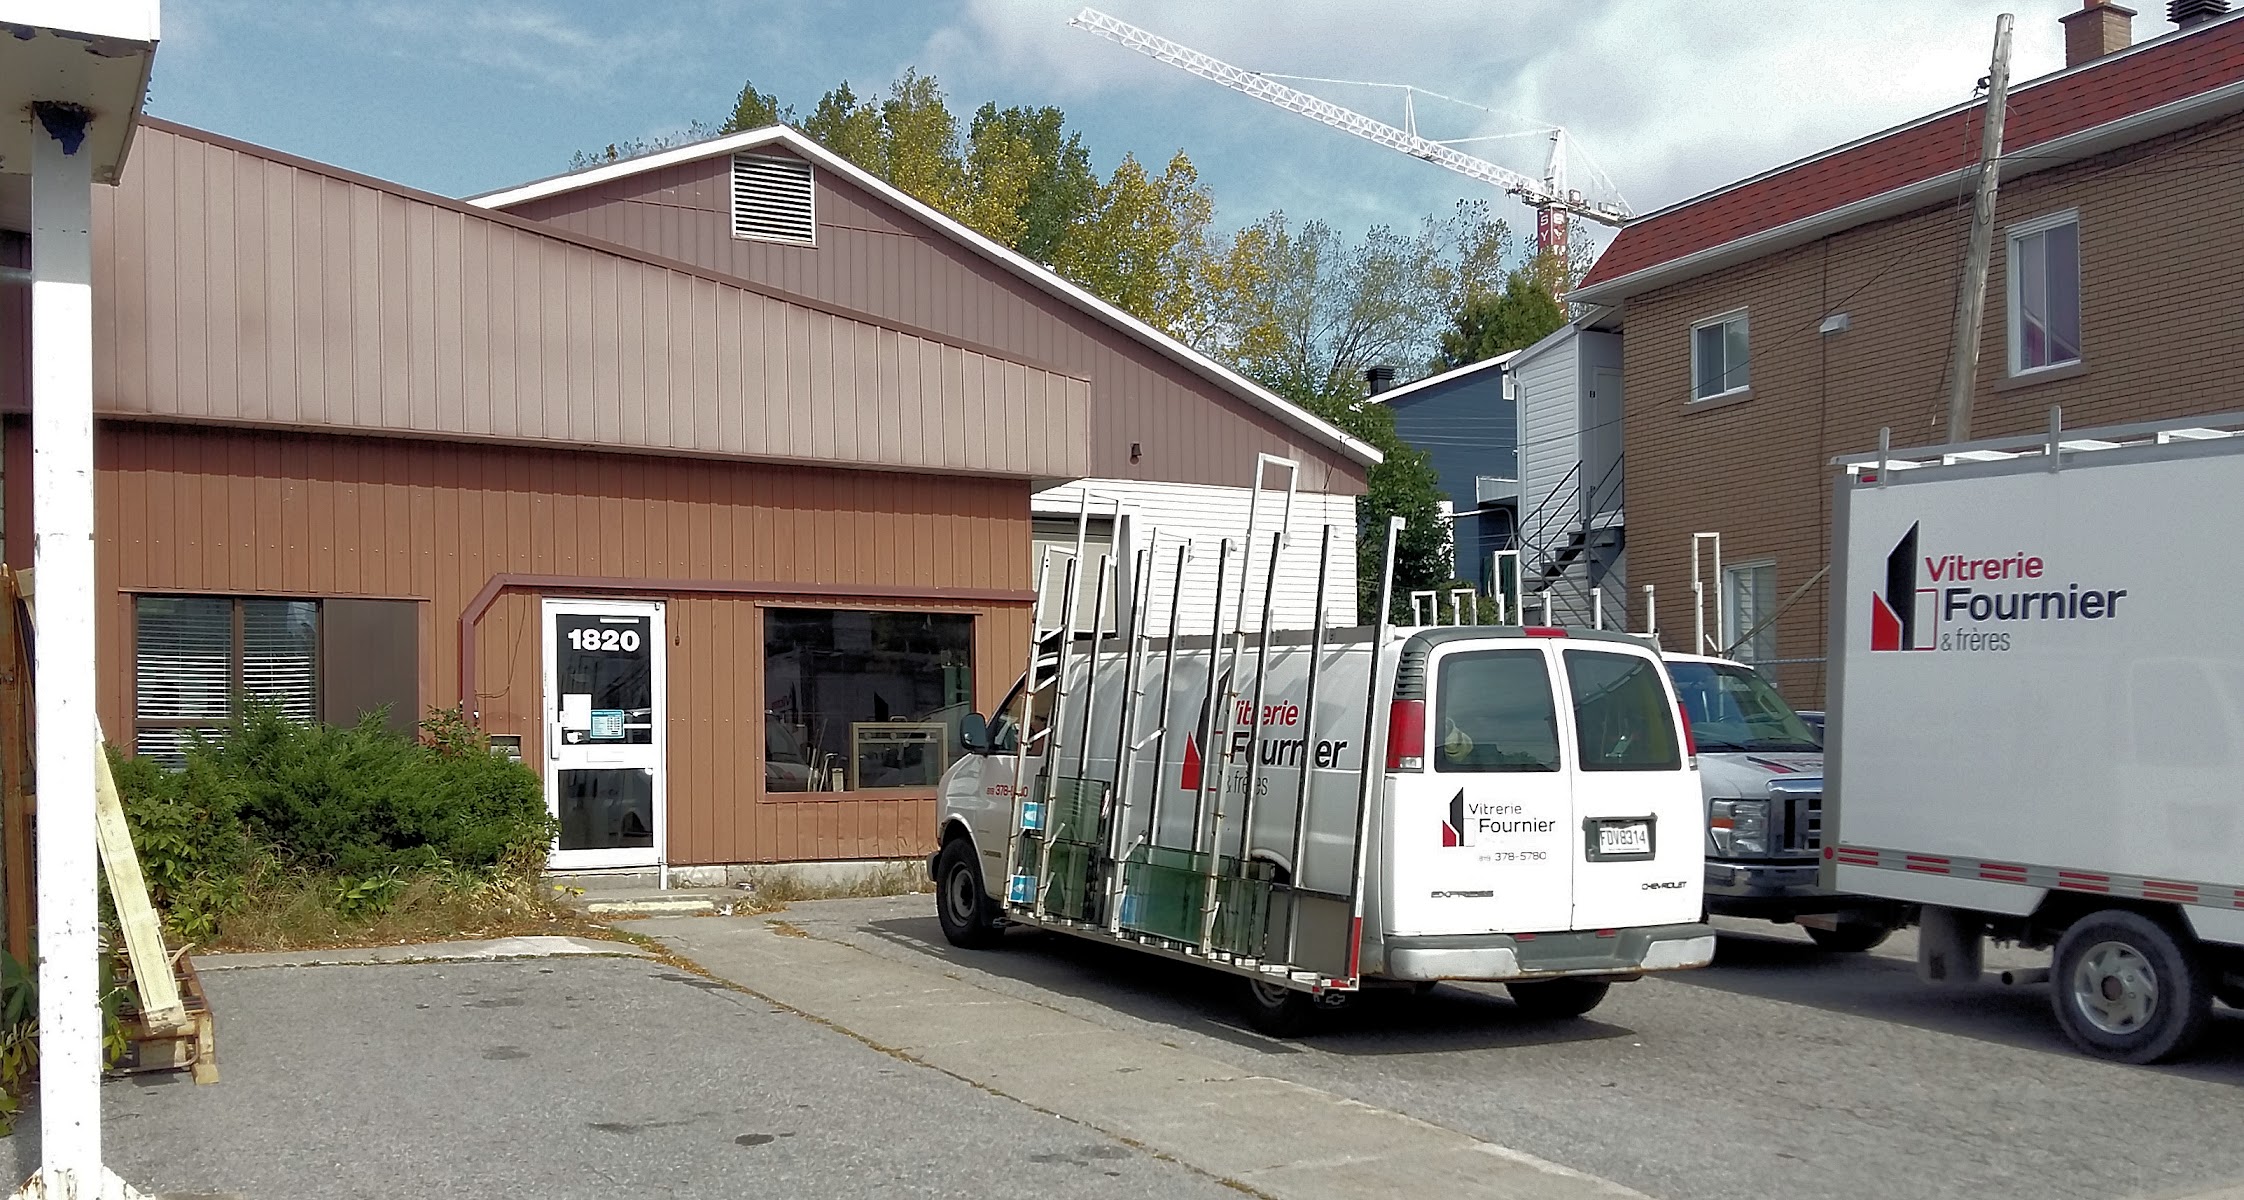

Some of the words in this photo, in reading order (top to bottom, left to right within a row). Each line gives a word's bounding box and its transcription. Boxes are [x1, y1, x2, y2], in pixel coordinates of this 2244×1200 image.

[1925, 551, 2045, 582] Vitrerie
[1943, 583, 2128, 622] Fournier
[567, 628, 641, 652] 1820
[1940, 633, 1953, 651] &
[1955, 626, 2011, 652] frères
[1236, 700, 1299, 726] iterie
[1229, 731, 1348, 768] Furner
[1233, 770, 1269, 796] frèes
[1468, 803, 1522, 815] Vitrerie
[1479, 818, 1556, 833] Fournier
[1600, 829, 1646, 846] FDV8314
[1494, 851, 1547, 861] 378-5780
